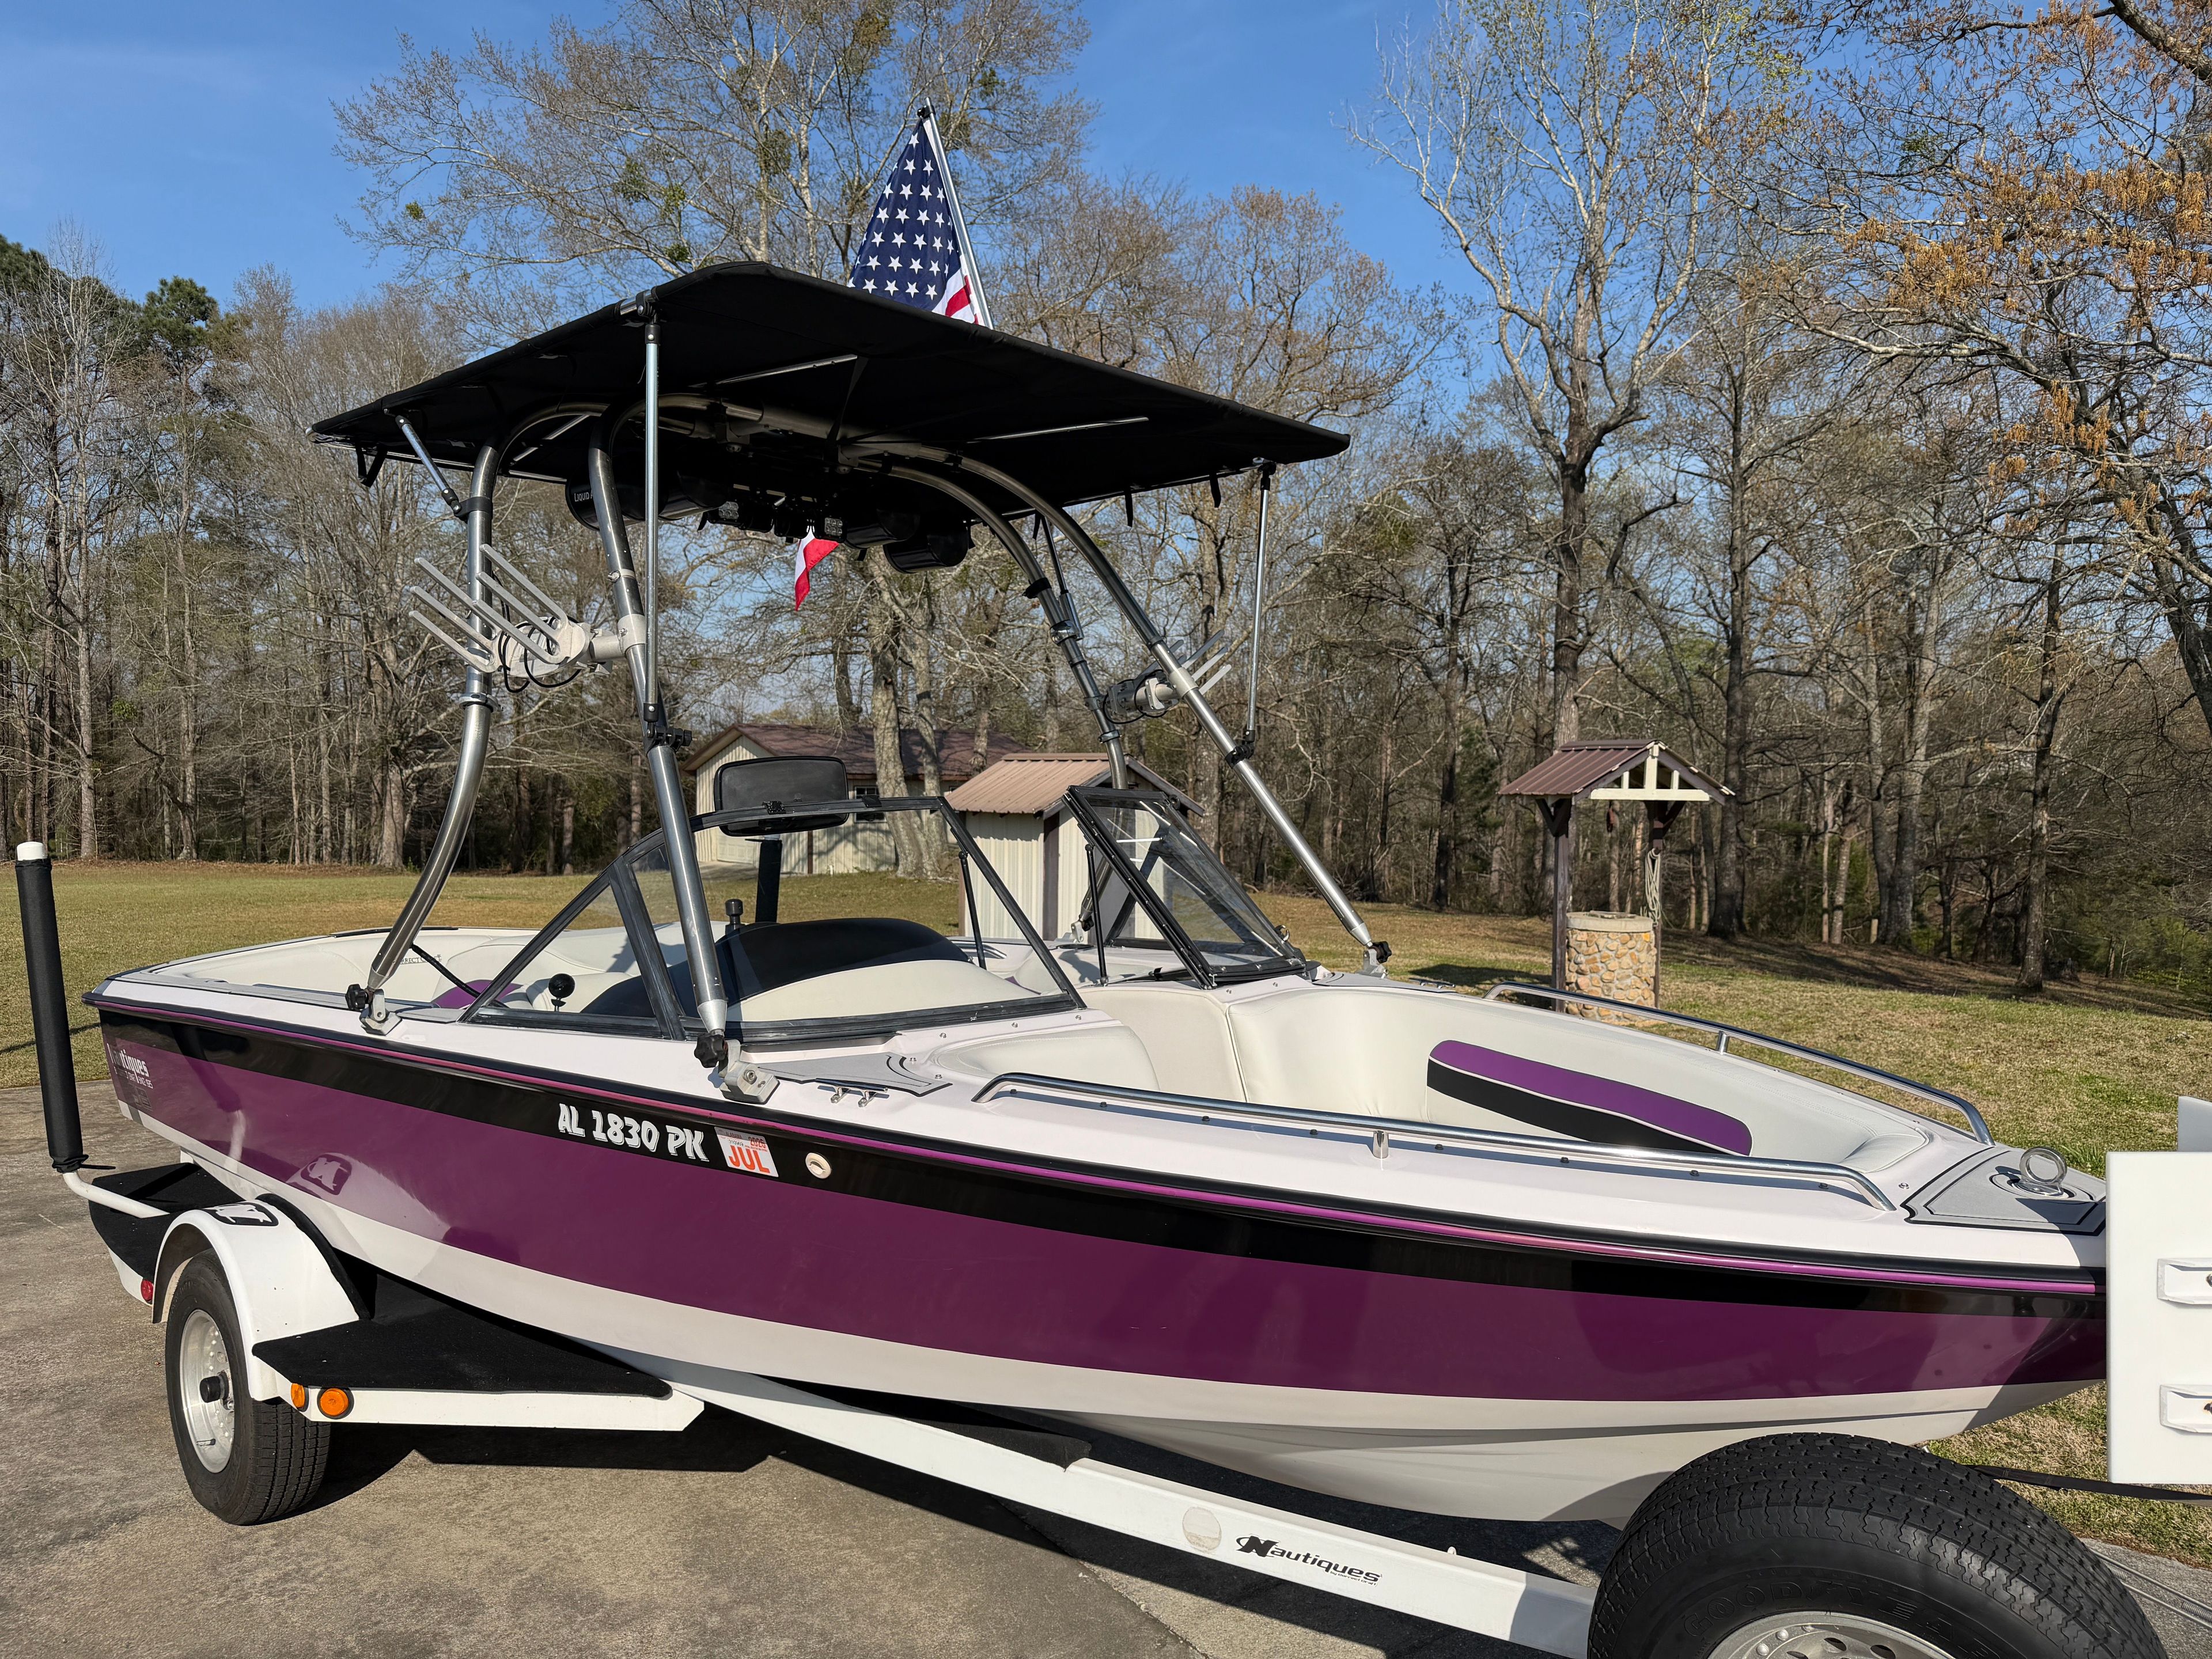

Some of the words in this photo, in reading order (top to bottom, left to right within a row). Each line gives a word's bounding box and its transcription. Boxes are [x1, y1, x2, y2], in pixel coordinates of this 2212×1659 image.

[574, 492, 590, 502] LIQUID
[558, 1103, 586, 1138] AL
[591, 1109, 660, 1153] 1830
[665, 1124, 710, 1162] PK
[728, 1145, 771, 1174] JUL
[1235, 1535, 1379, 1582] Nautiques
